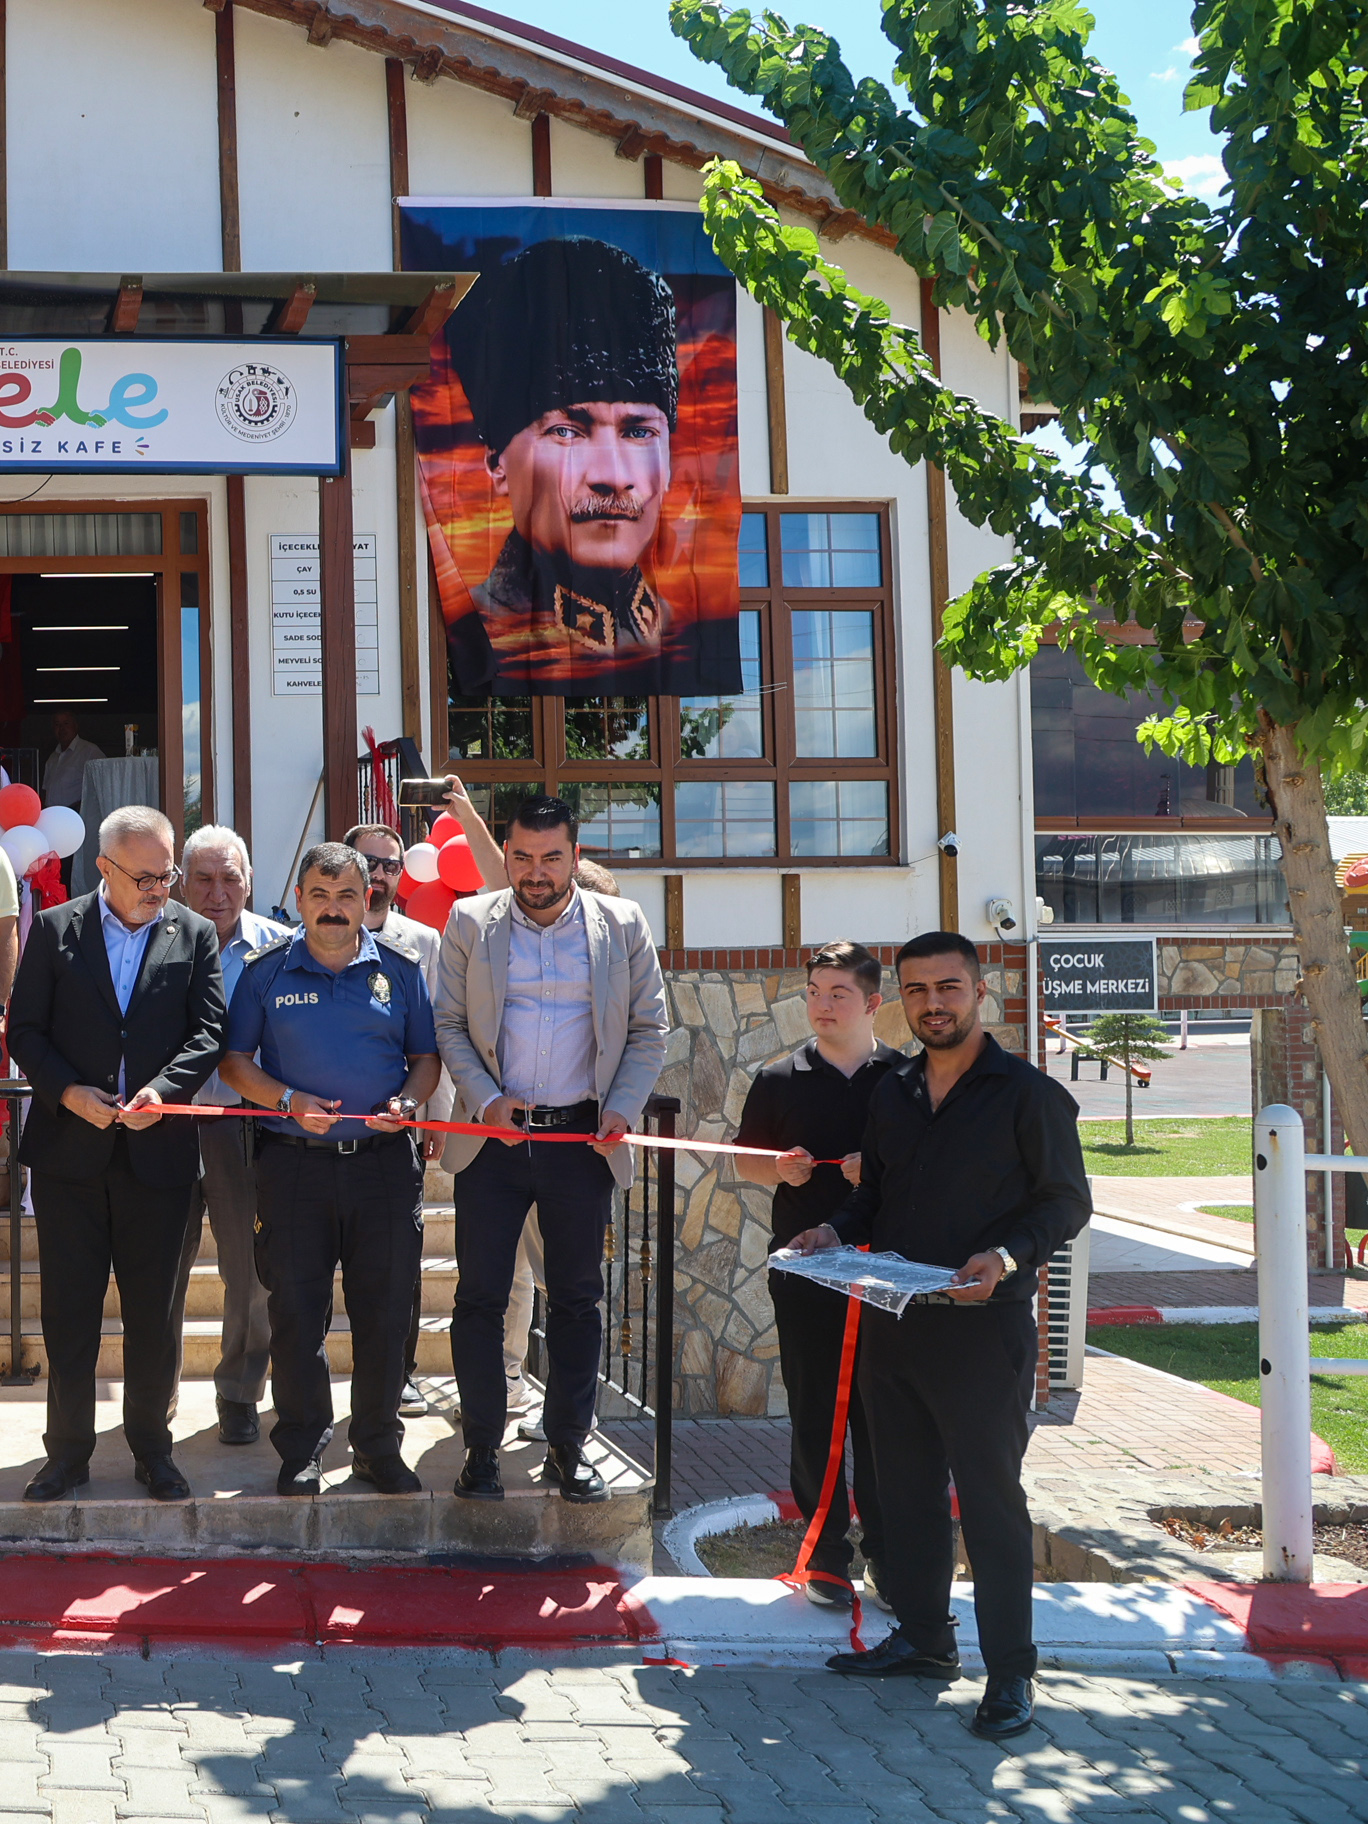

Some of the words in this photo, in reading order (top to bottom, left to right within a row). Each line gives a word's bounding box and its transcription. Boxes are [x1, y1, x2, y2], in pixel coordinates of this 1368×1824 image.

[57, 440, 122, 454] KAFE
[296, 566, 312, 574] ÇAY
[278, 656, 311, 664] MEYVELİ
[1049, 953, 1105, 972] ÇOCUK
[1042, 978, 1083, 998] ÜŞME
